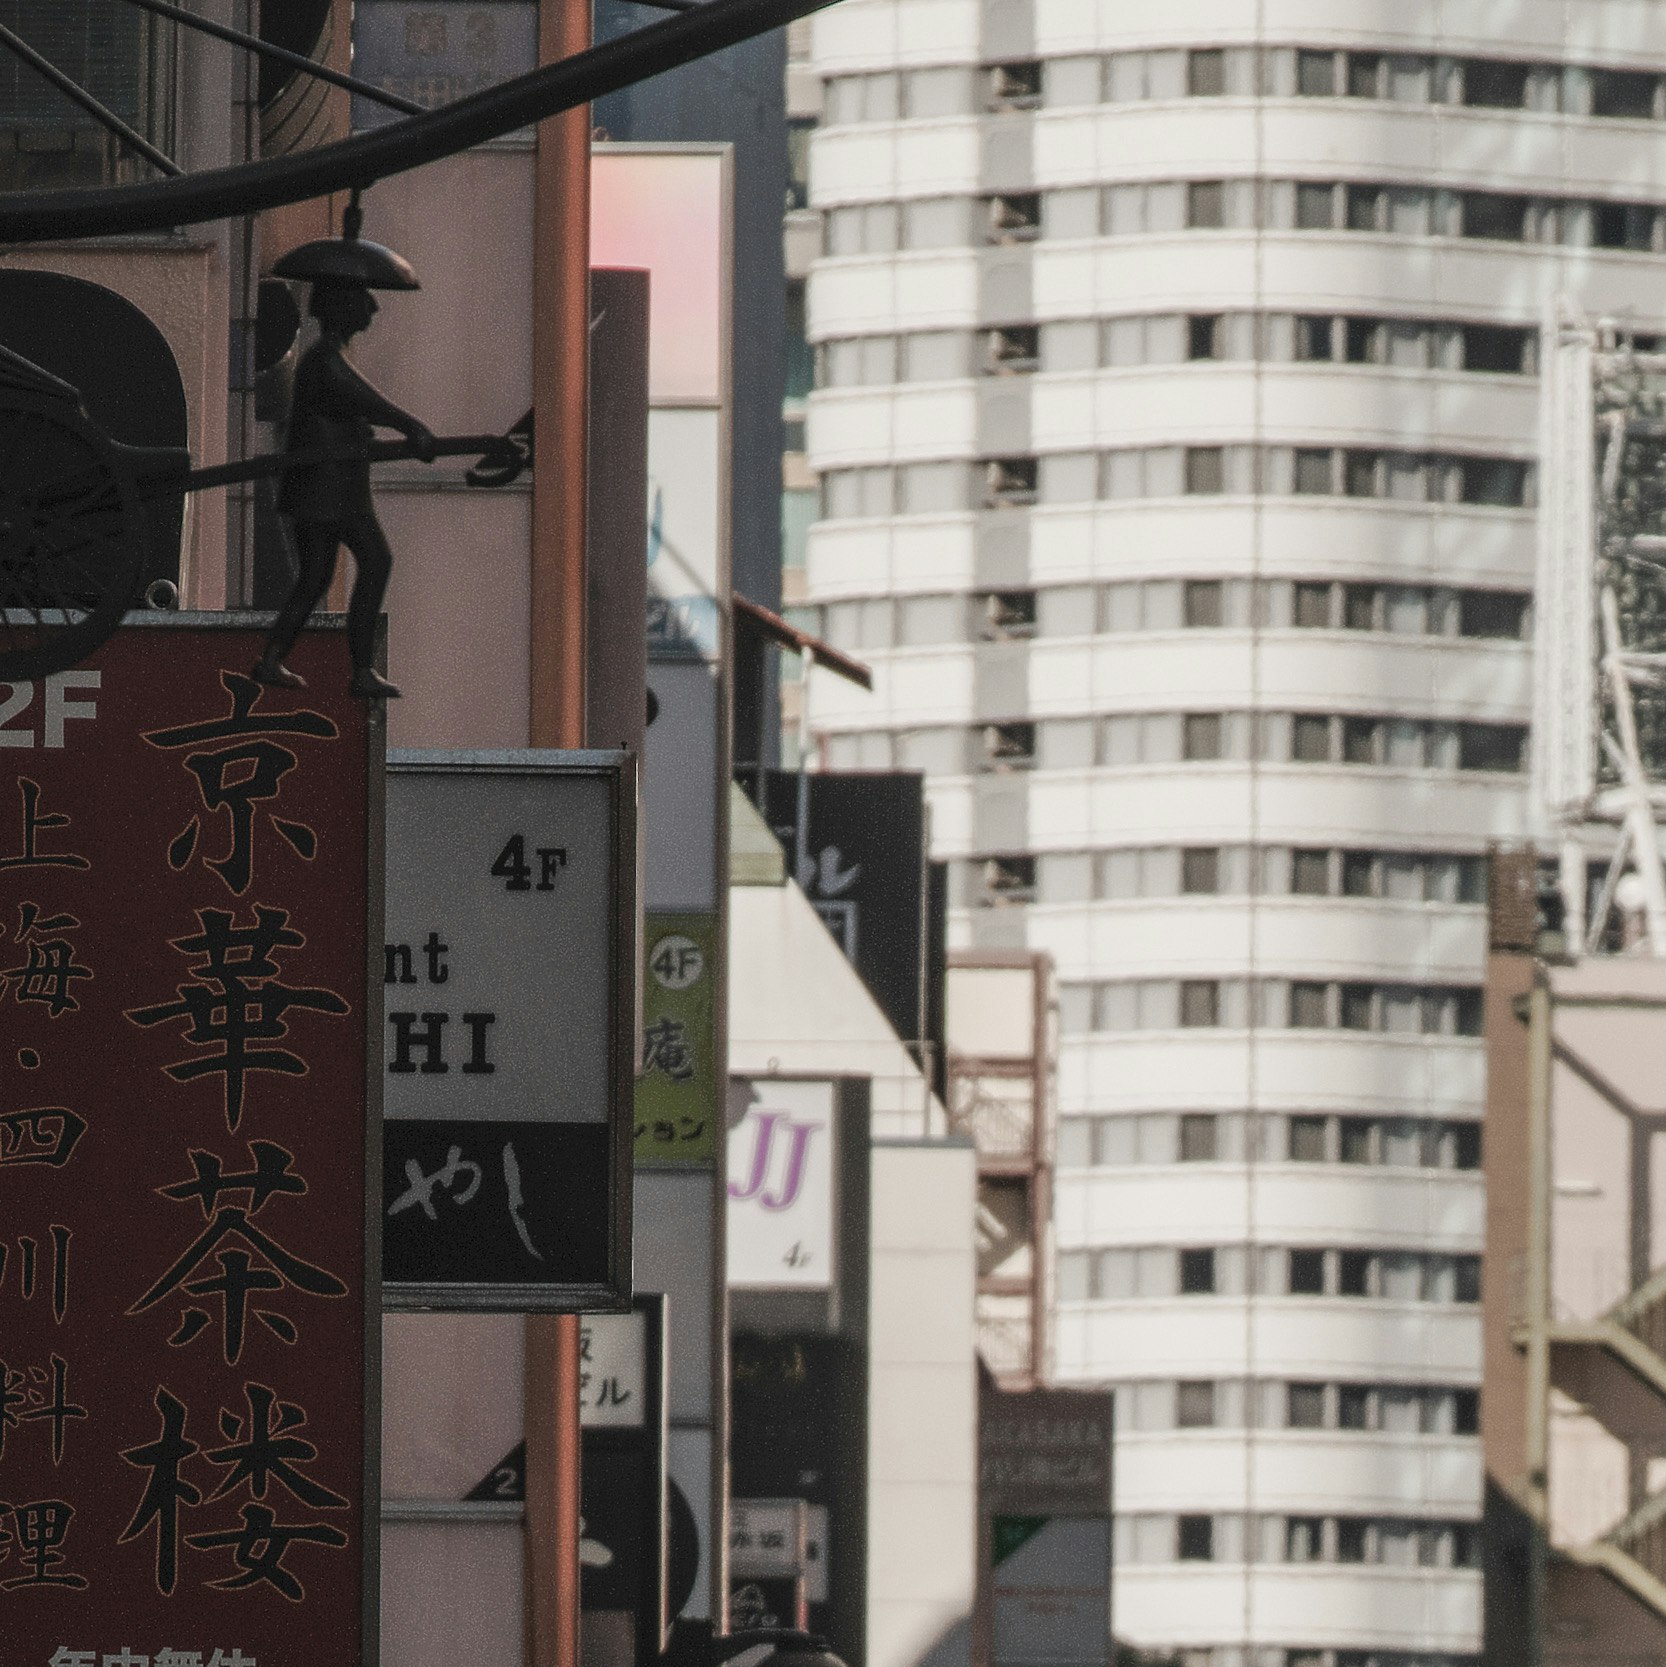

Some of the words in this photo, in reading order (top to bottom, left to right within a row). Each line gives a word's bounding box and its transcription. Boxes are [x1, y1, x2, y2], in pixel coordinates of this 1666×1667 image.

[0, 671, 101, 748] 2F
[490, 834, 567, 891] 4F
[652, 947, 699, 979] 4F
[118, 669, 351, 1602] 京華茶楼
